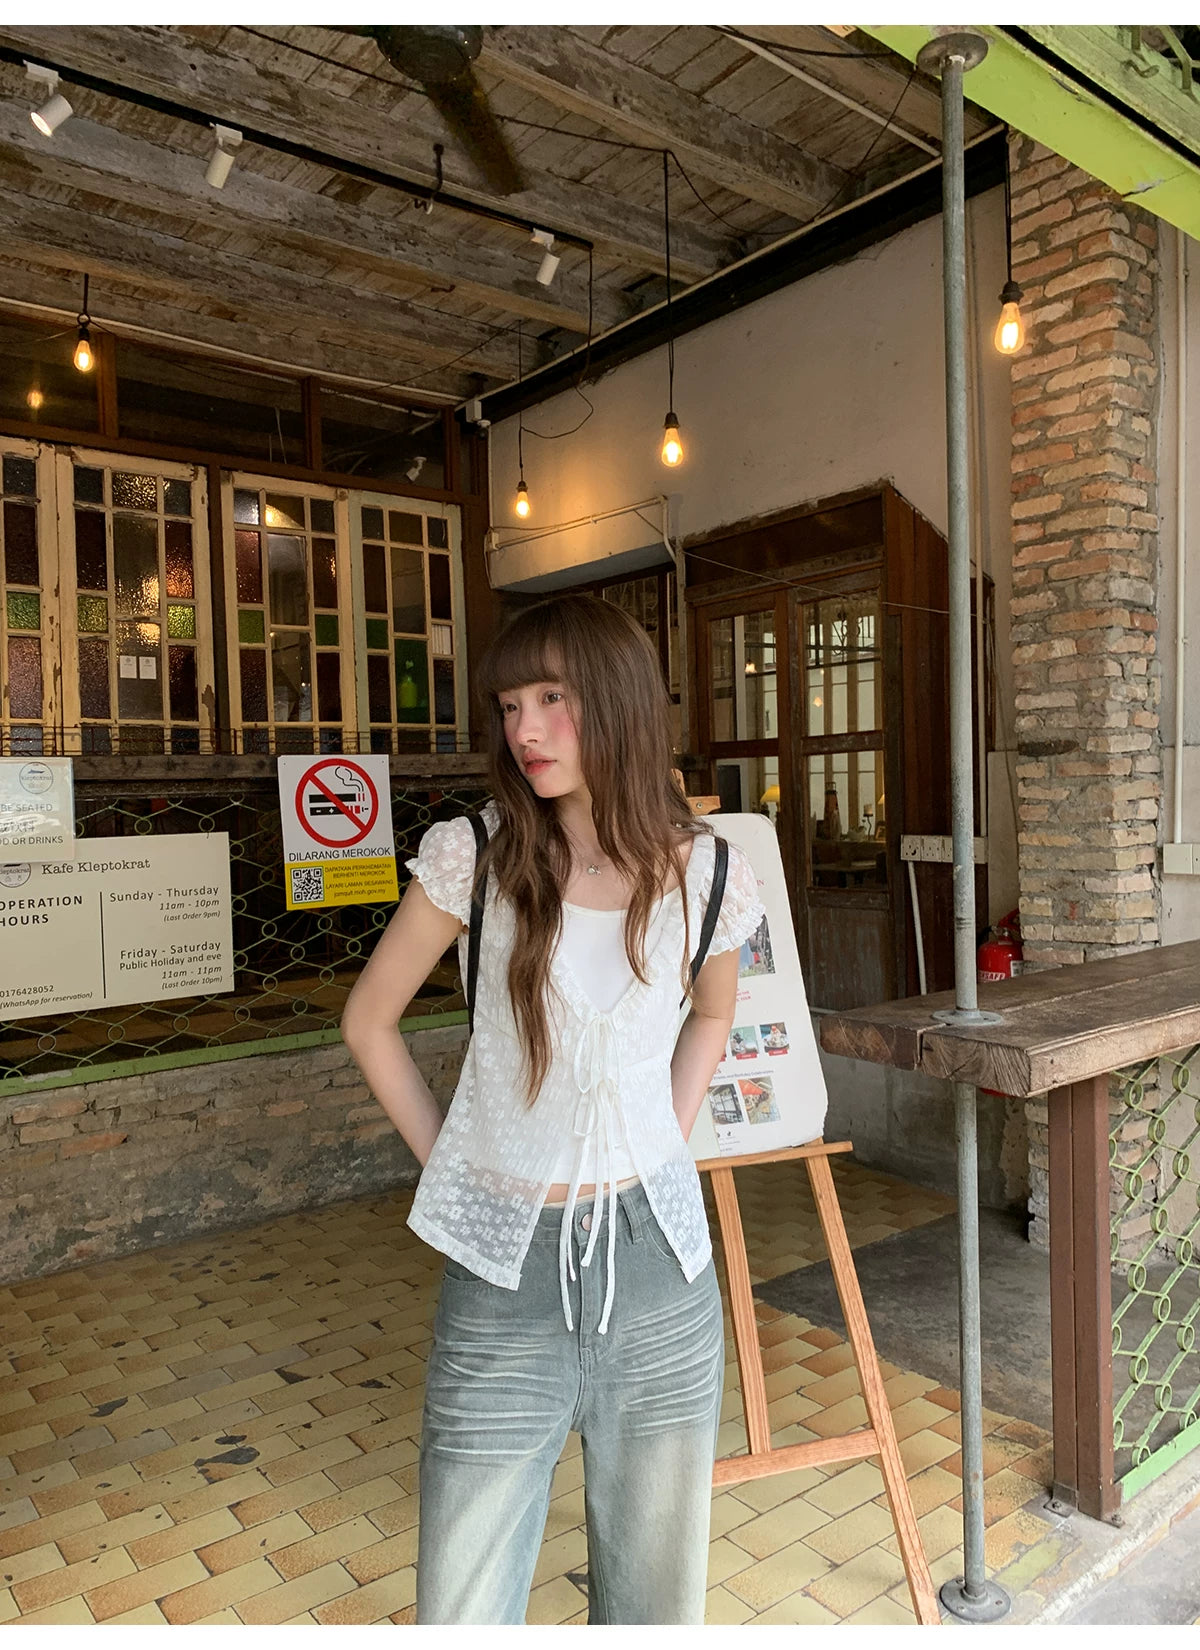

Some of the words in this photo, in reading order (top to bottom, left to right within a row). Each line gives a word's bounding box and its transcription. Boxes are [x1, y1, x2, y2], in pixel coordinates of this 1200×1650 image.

[16, 804, 53, 812] SEATED
[12, 837, 26, 845] OR
[28, 835, 64, 845] DRINKS
[289, 849, 340, 862] DILARANG
[342, 847, 391, 858] MEROKOK
[42, 863, 73, 875] Kafe
[78, 859, 150, 874] Kleptokrat
[109, 890, 154, 902] Sunday
[166, 885, 219, 897] Thursday
[0, 895, 83, 911] OPERATION
[160, 902, 185, 910] 11am
[195, 899, 220, 909] 10pm
[163, 914, 181, 922] (Last
[182, 912, 202, 920] Order
[203, 910, 221, 919] 9pm)
[120, 948, 157, 959] Friday
[170, 941, 221, 955] Saturday
[120, 960, 148, 970] Public
[150, 957, 185, 968] Holiday
[187, 954, 204, 962] and
[162, 970, 187, 979] 11am
[197, 966, 222, 976] 11pm
[162, 982, 179, 990] (Last
[180, 979, 200, 987] Order
[201, 976, 223, 985] 10pm)
[0, 985, 54, 998] 0176428052
[0, 997, 39, 1010] (WhatsApp
[41, 995, 51, 1005] for
[52, 992, 93, 1003] reservation)
